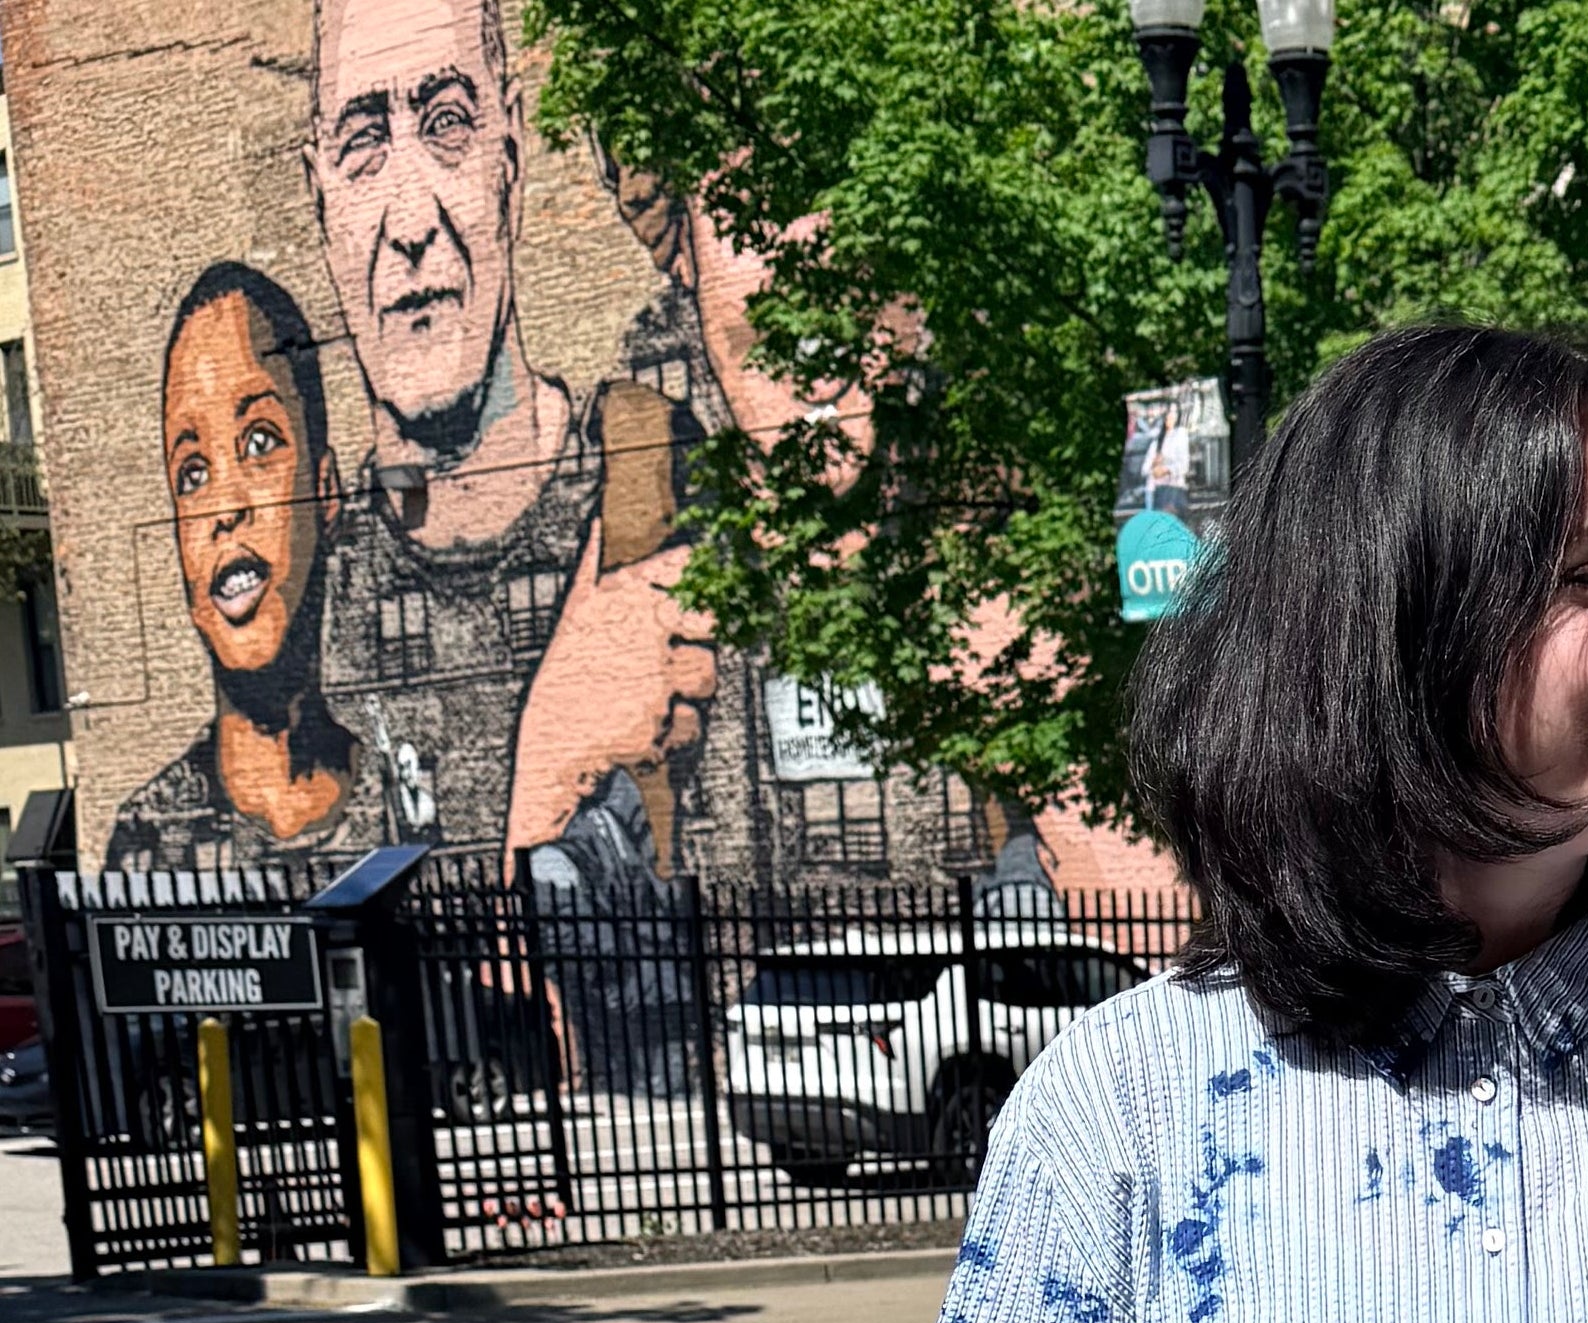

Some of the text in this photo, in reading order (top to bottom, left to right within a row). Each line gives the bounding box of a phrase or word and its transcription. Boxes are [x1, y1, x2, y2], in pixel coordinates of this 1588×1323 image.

[114, 924, 291, 960] PAY & DISPLAY
[154, 969, 262, 1004] PARKING
